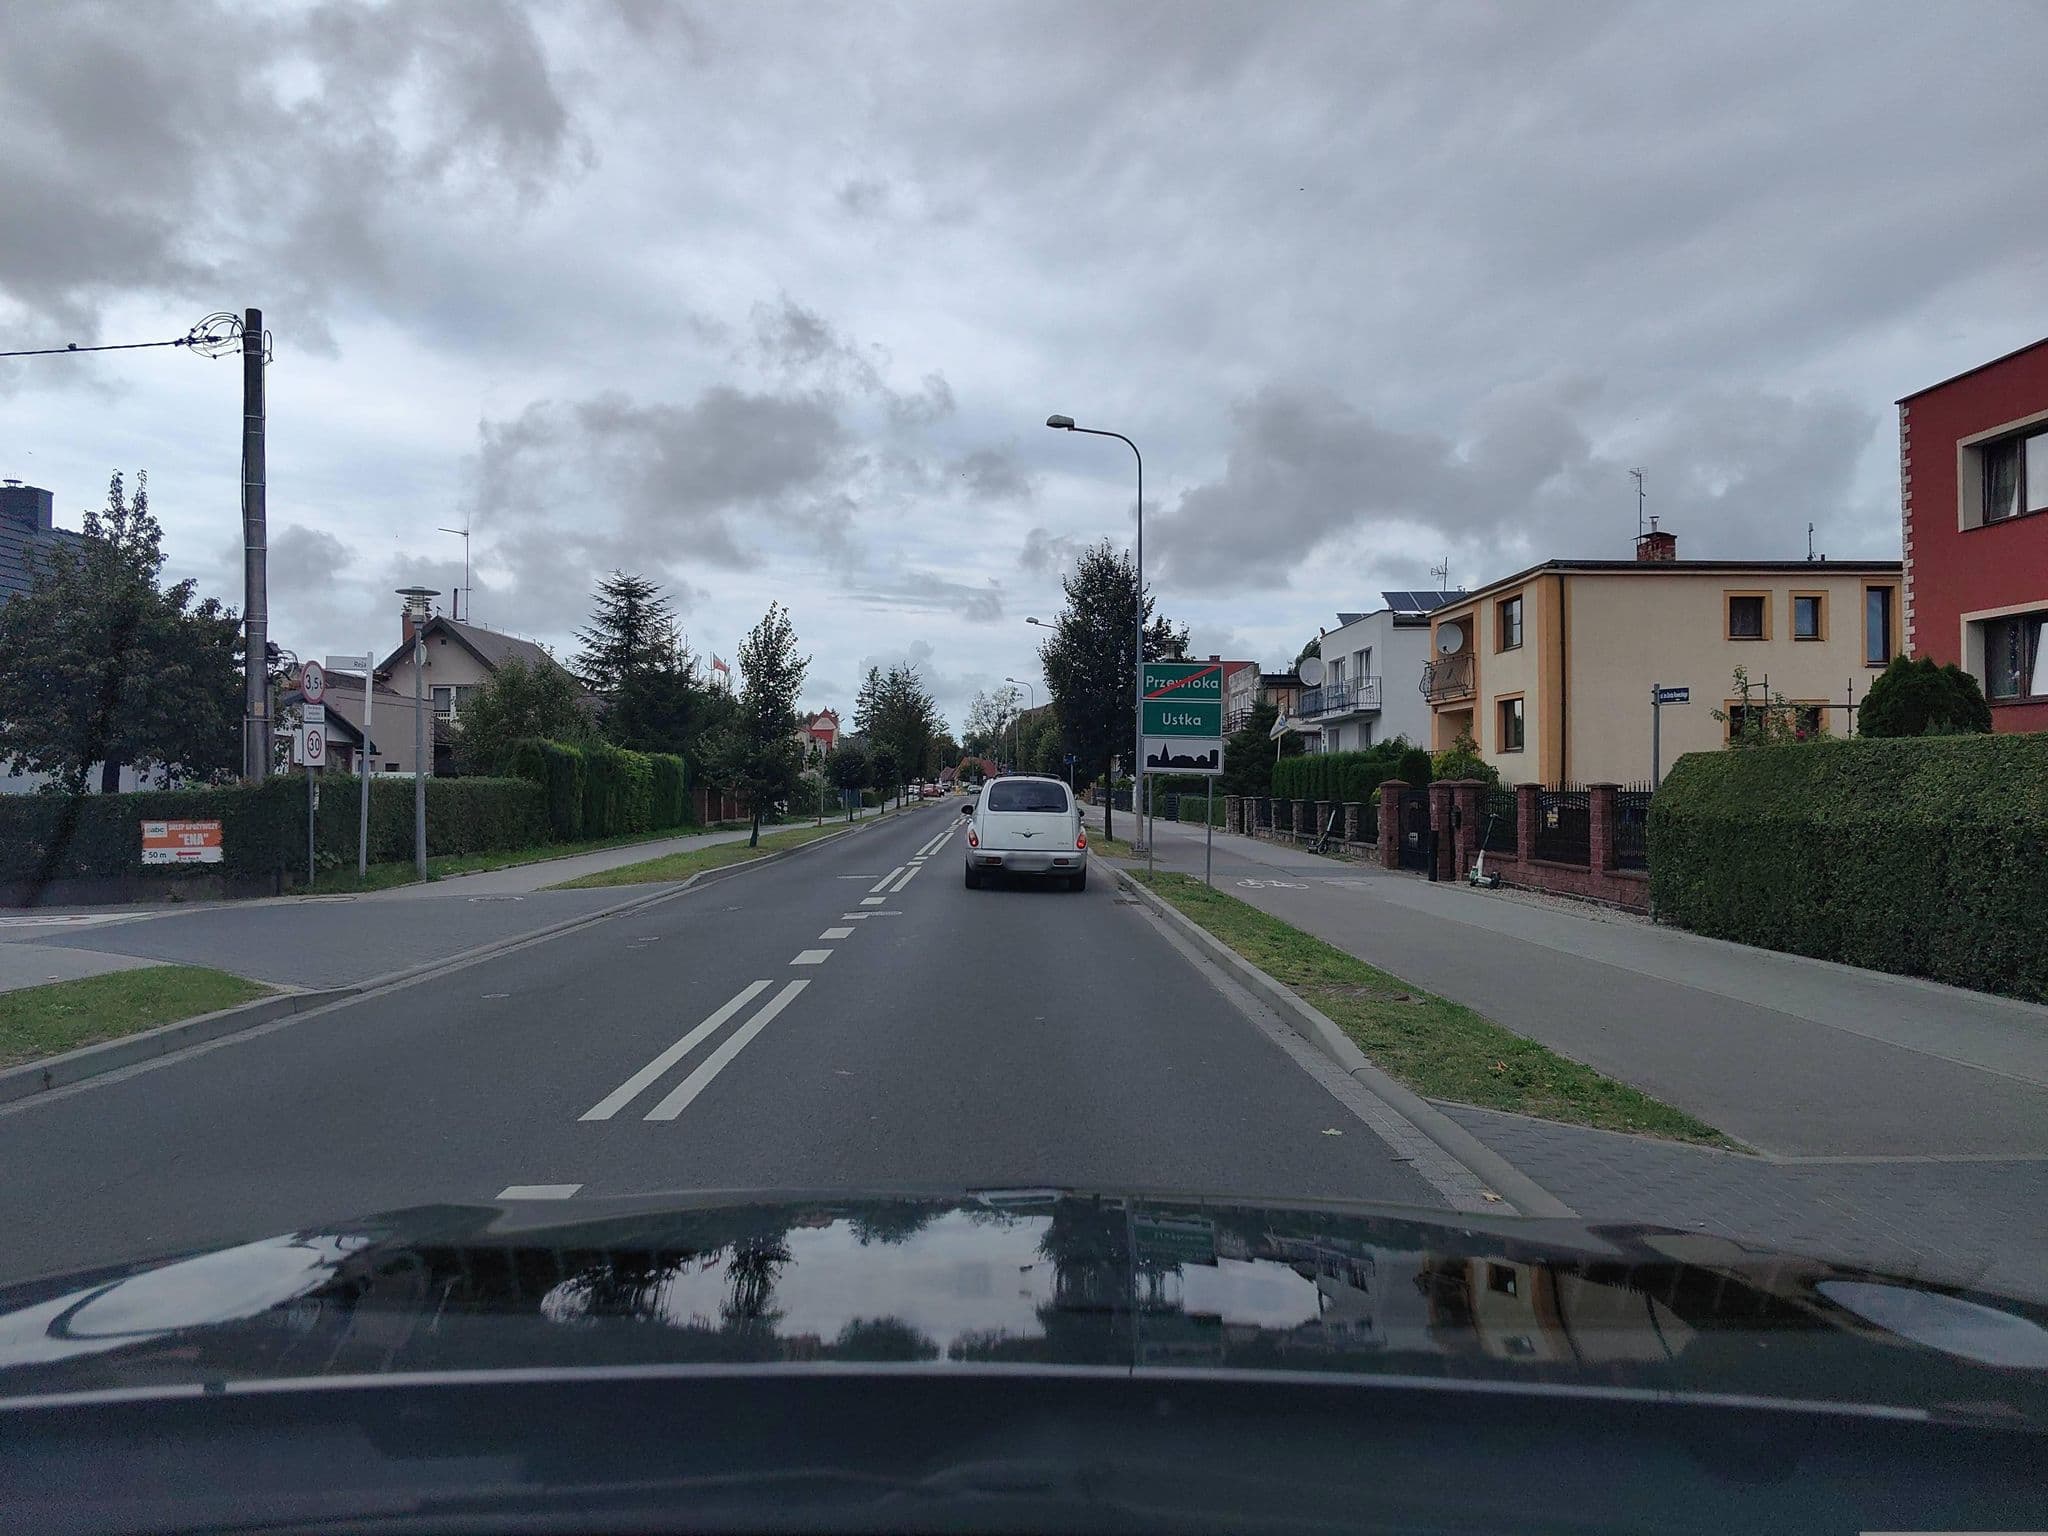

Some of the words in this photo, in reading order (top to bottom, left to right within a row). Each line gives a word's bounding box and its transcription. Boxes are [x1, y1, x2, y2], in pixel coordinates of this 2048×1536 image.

[1162, 712, 1201, 726] Ustka
[309, 738, 320, 752] 30
[148, 851, 158, 859] 50
